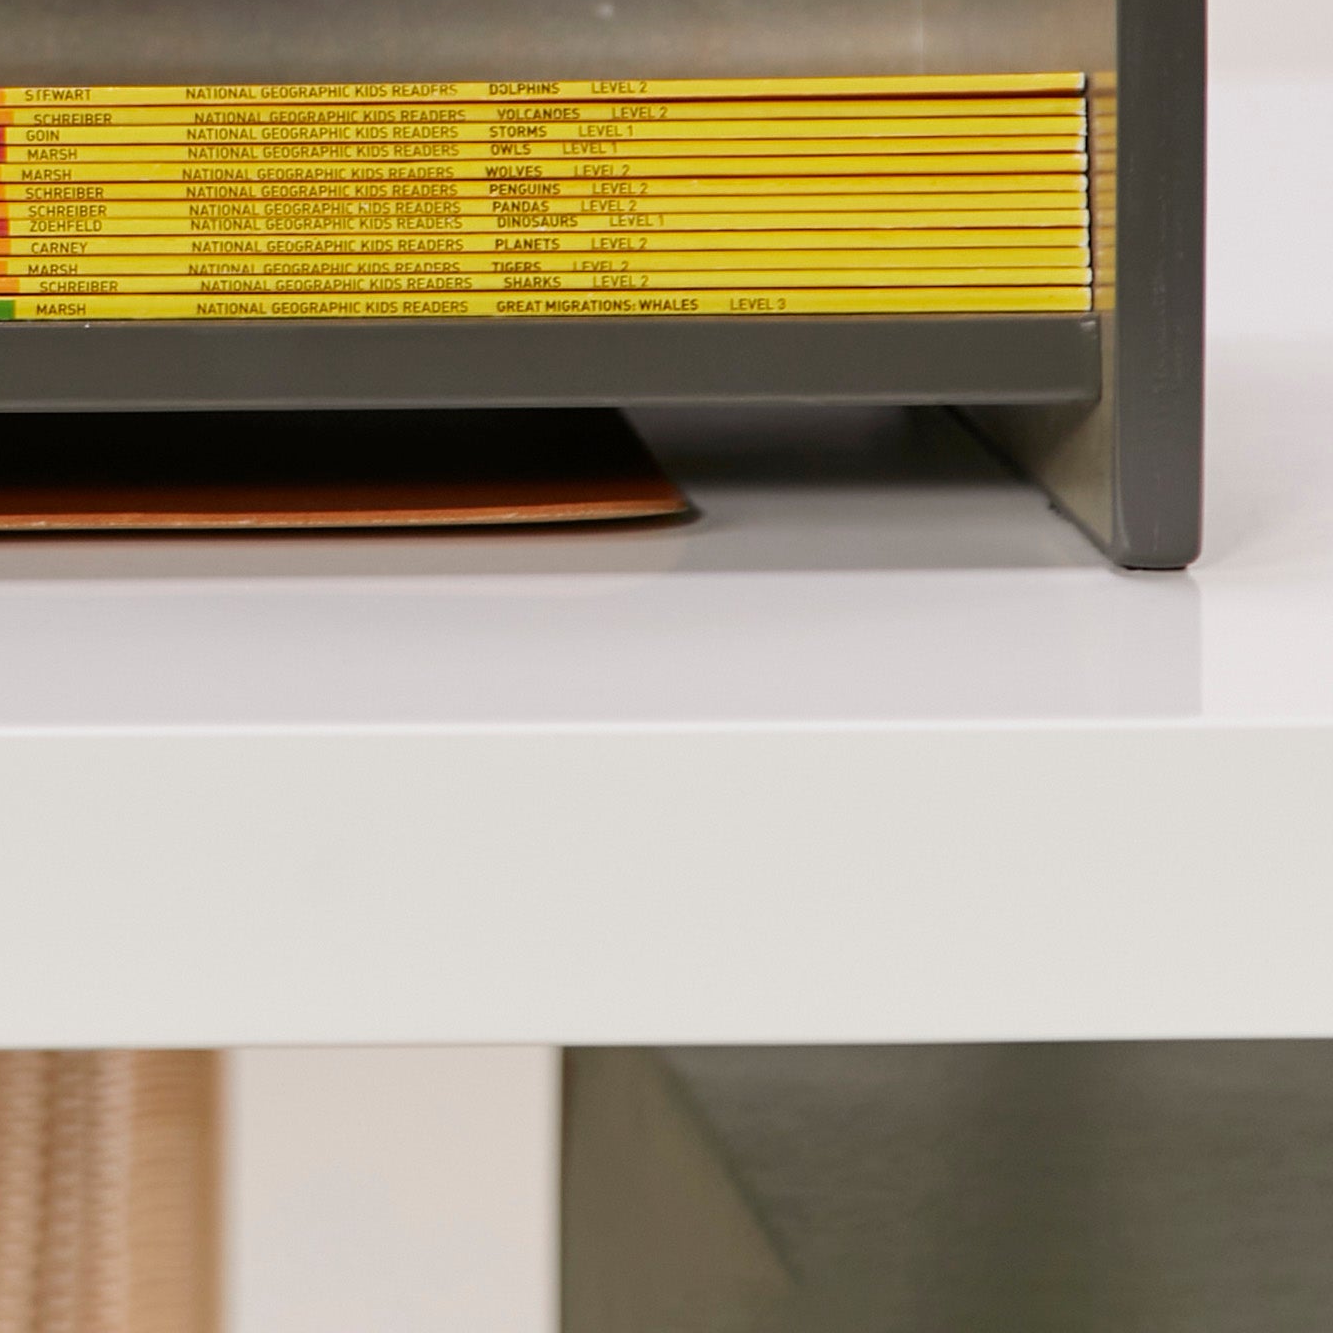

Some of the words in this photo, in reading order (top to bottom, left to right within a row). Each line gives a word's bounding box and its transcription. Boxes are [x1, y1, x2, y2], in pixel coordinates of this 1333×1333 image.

[25, 129, 60, 142] GOIN
[186, 127, 257, 141] NATIONAL
[261, 126, 350, 140] GEOGRAPHIC
[355, 126, 388, 139] KIDS
[392, 126, 458, 139] READERS
[489, 125, 547, 139] STORMS
[578, 124, 623, 138] LEVEL
[627, 125, 633, 136] 1
[27, 148, 77, 161] MARSH
[187, 145, 258, 159] NATIONAL
[262, 144, 352, 159] GEOGRAPHIC
[356, 144, 389, 158] KIDS
[393, 143, 459, 157] READERS
[490, 142, 531, 156] OWLS
[562, 141, 606, 155] LEVEL
[611, 141, 617, 154] 1
[25, 186, 104, 201] SCHREIBER
[186, 185, 256, 199] NATIONAL
[260, 185, 350, 199] GEOGRAPHIC
[355, 184, 388, 198] KIDS
[392, 183, 457, 198] READERS
[489, 183, 561, 197] PENGUINS
[592, 182, 636, 196] LEVEL
[640, 182, 647, 196] 2
[29, 218, 102, 233] ZOEHFELD
[190, 217, 261, 232] NATIONAL
[265, 216, 354, 231] GEOGRAPHIC
[359, 216, 392, 230] KIDS
[396, 215, 463, 230] READERS
[496, 214, 578, 229] DINOSAURS
[609, 214, 653, 227] LEVEL
[658, 214, 666, 227] 1
[31, 241, 88, 255] CARNEY
[191, 240, 262, 254] NATIONAL
[266, 239, 355, 254] GEOGRAPHIC
[360, 239, 393, 253] KIDS
[397, 238, 464, 253] READERS
[494, 237, 560, 252] PLANETS
[591, 237, 635, 251] LEVEL
[638, 237, 647, 251] 2
[36, 303, 86, 316] MARSH
[196, 302, 267, 315] NATIONAL
[271, 301, 360, 315] GEOGRAPHIC
[365, 301, 398, 314] KIDS
[402, 300, 468, 314] READERS
[496, 300, 542, 313] GREAT
[545, 299, 637, 312] MIGRATIONS:
[639, 298, 700, 311] WHALES
[729, 298, 774, 311] LEVEL
[775, 298, 787, 311] 3
